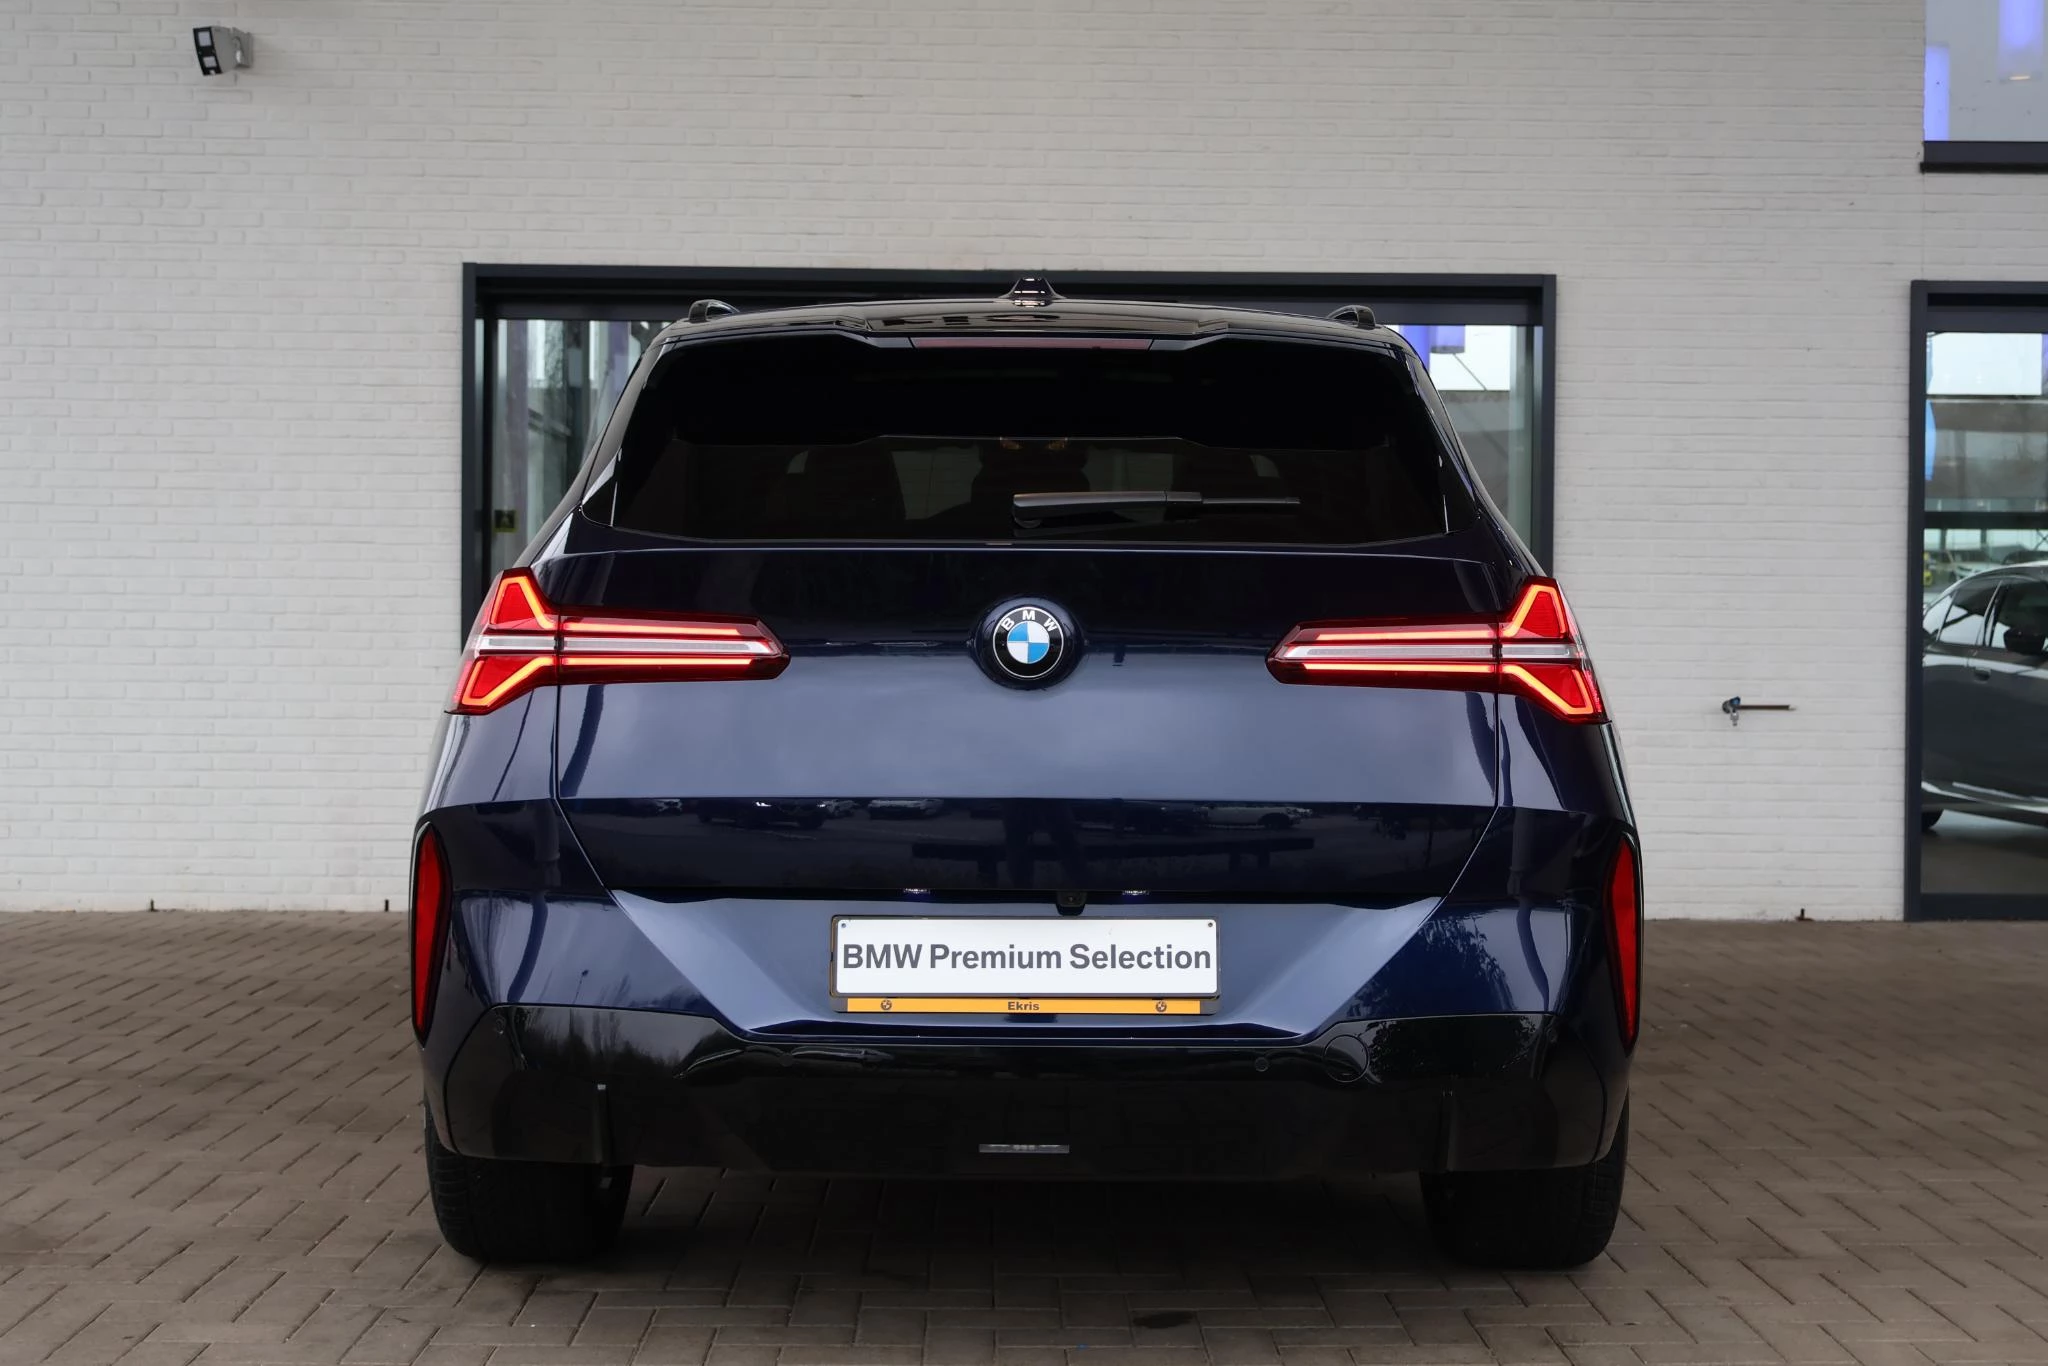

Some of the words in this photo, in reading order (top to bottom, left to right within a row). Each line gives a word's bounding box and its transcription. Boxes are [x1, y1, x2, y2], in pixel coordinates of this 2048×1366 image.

[1002, 610, 1058, 632] BMW
[843, 943, 922, 969] BMW
[930, 943, 1062, 969] Premium
[1070, 943, 1211, 969] Selection
[1007, 1001, 1040, 1011] Ekris
